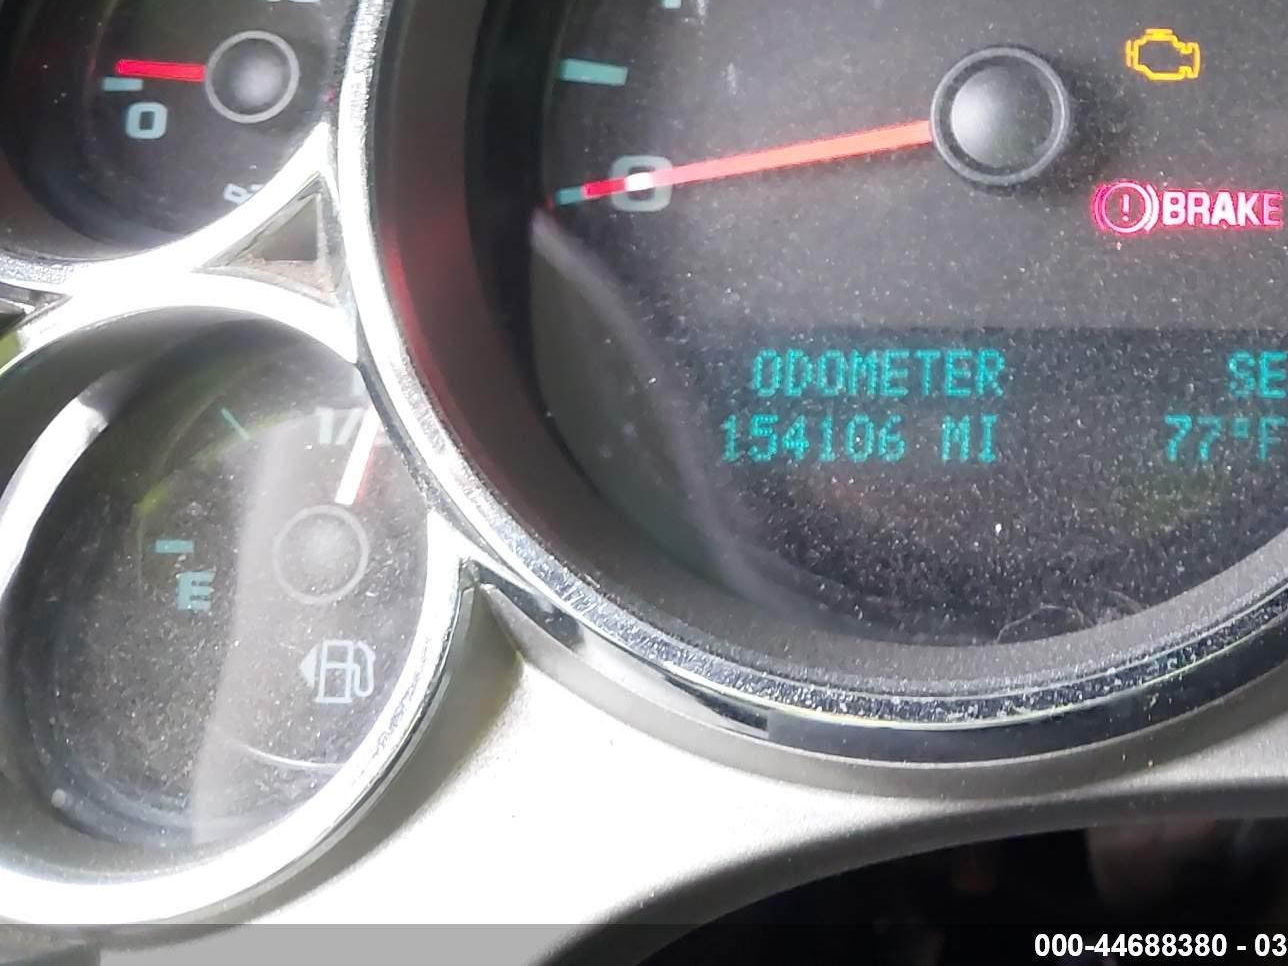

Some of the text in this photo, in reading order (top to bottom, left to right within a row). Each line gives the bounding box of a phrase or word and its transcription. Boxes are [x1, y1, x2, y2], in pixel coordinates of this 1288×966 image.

[125, 102, 168, 139] 0
[612, 155, 671, 211] 0
[1162, 191, 1283, 227] BRAKE
[752, 350, 1006, 396] ODOMETER
[1228, 351, 1288, 398] SE
[720, 414, 1000, 462] 154106 MI
[175, 571, 216, 611] E
